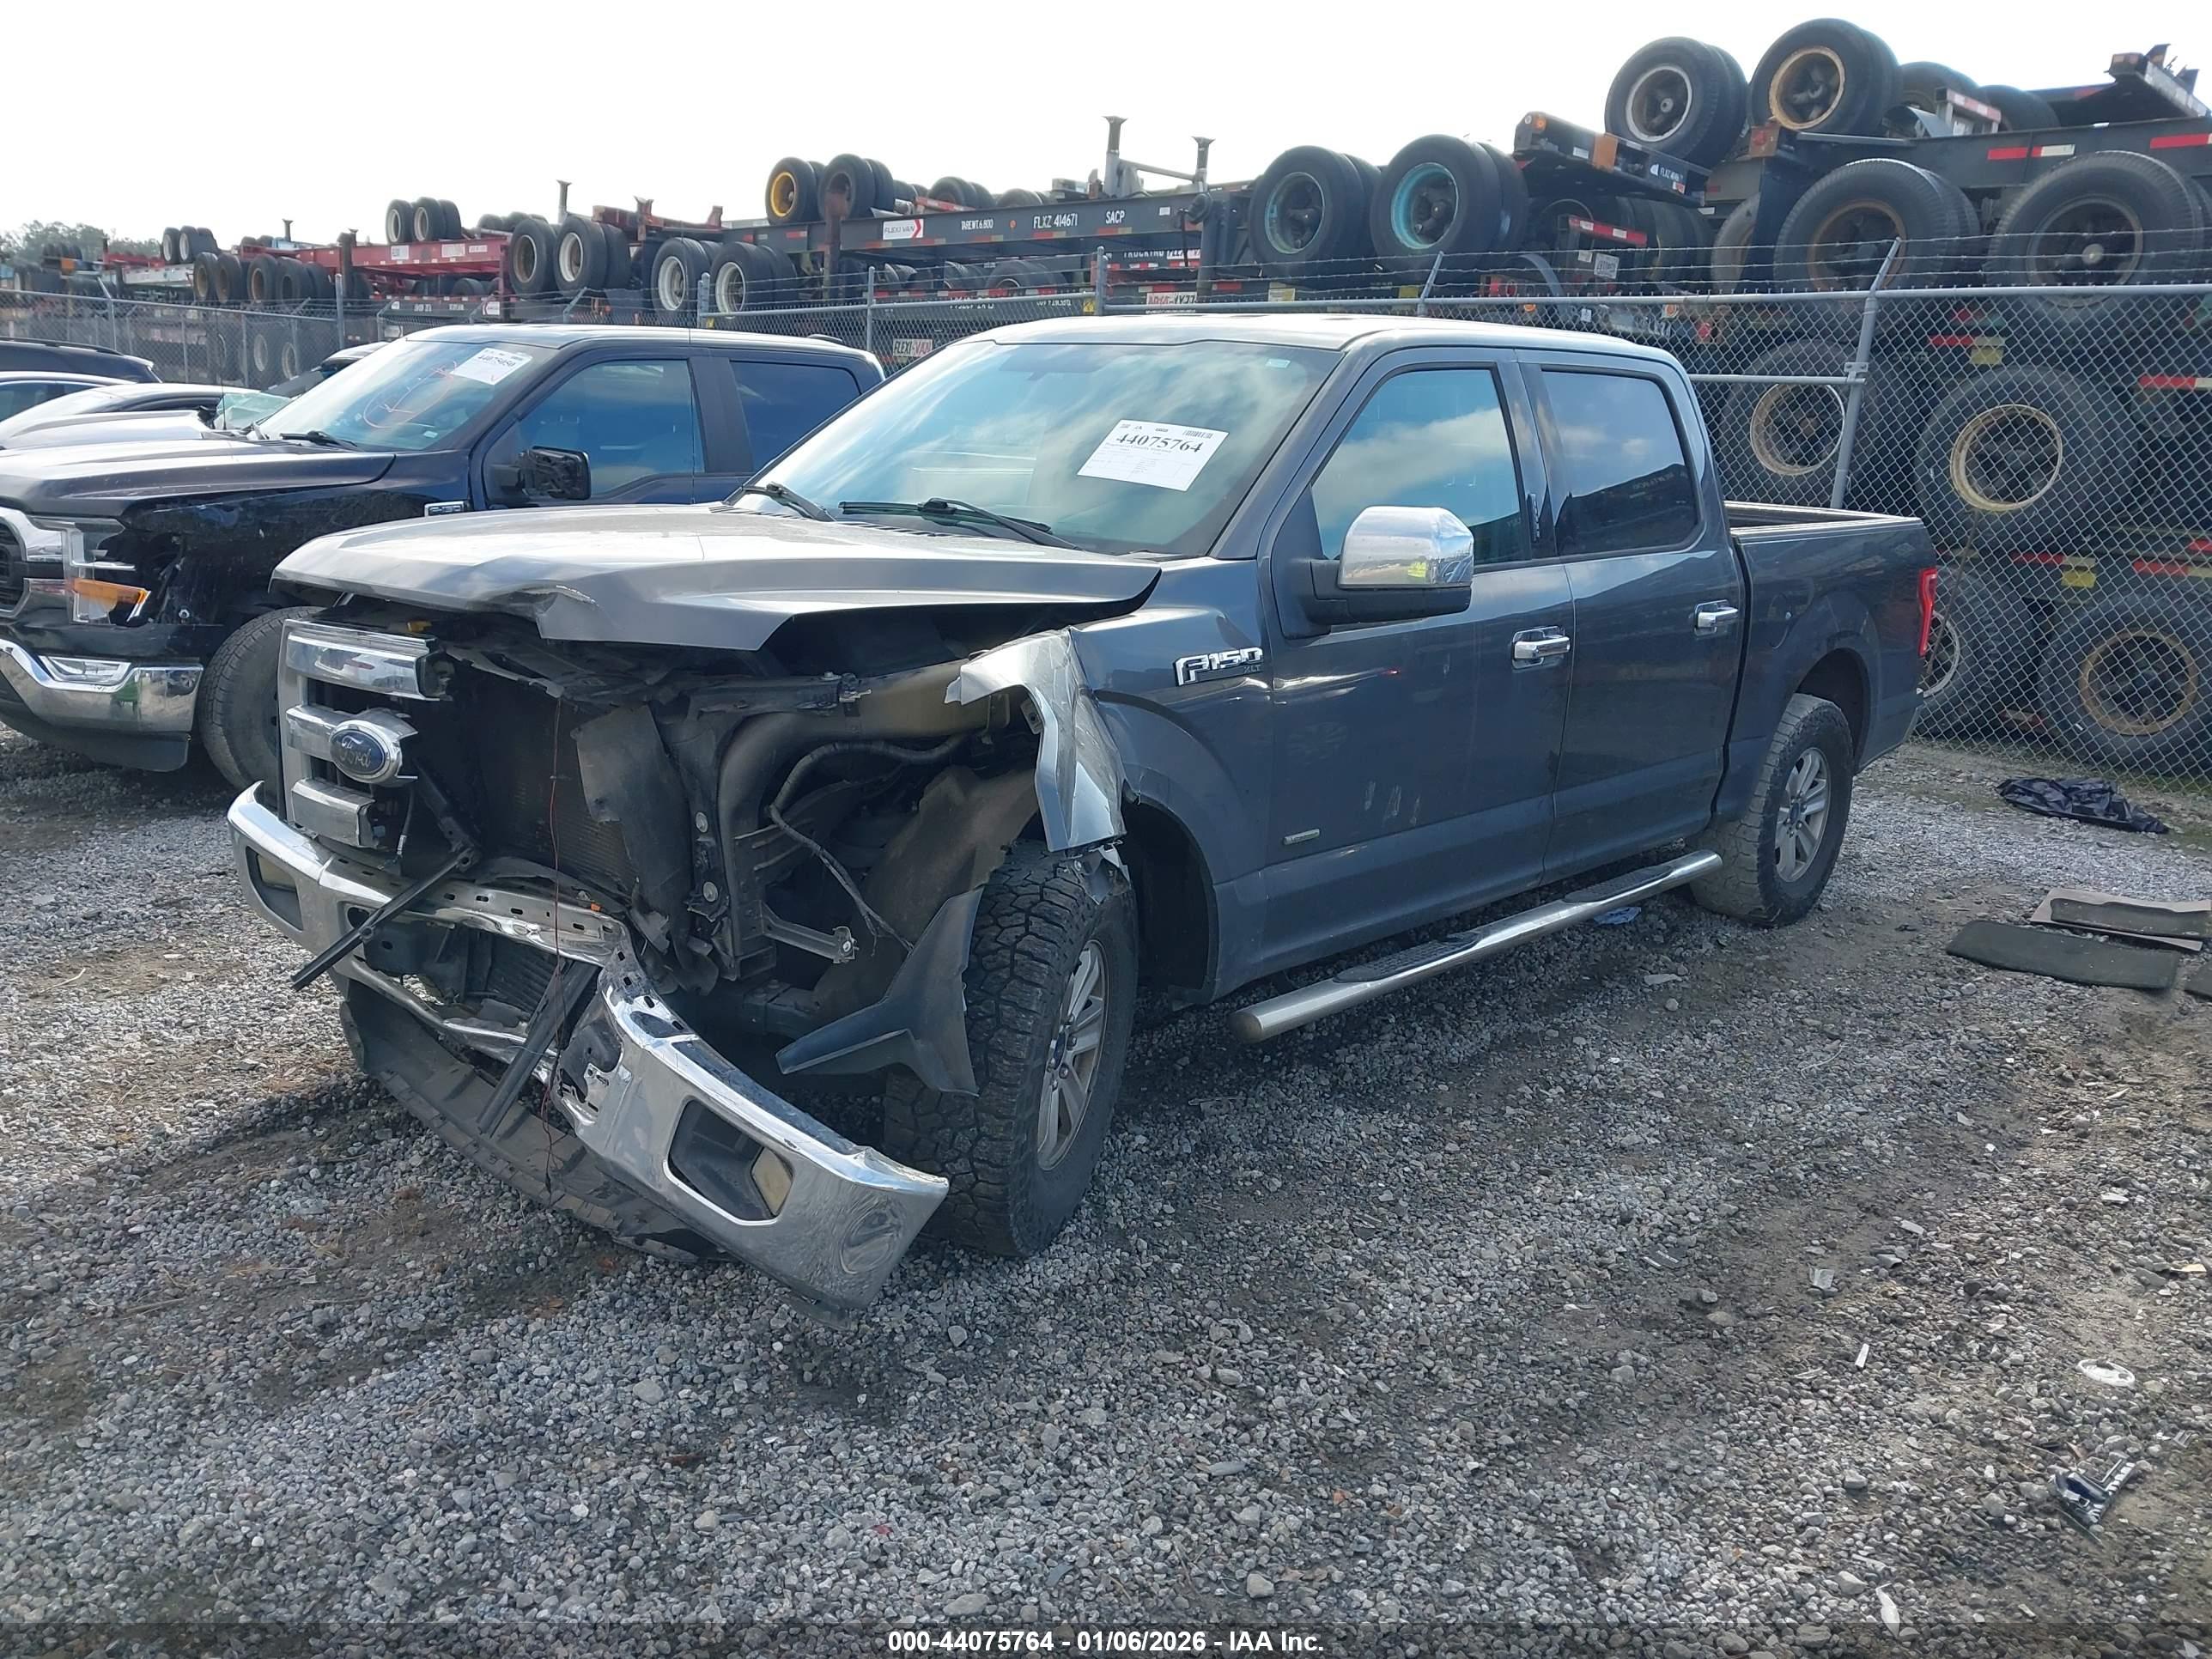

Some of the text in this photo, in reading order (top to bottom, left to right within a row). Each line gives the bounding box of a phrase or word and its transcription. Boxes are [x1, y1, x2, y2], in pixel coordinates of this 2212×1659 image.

[1033, 212, 1078, 228] FLXZ 414671
[1105, 210, 1125, 224] SACP
[1115, 433, 1204, 453] 44075764
[1243, 664, 1261, 674] XLT
[341, 734, 372, 768] Ford
